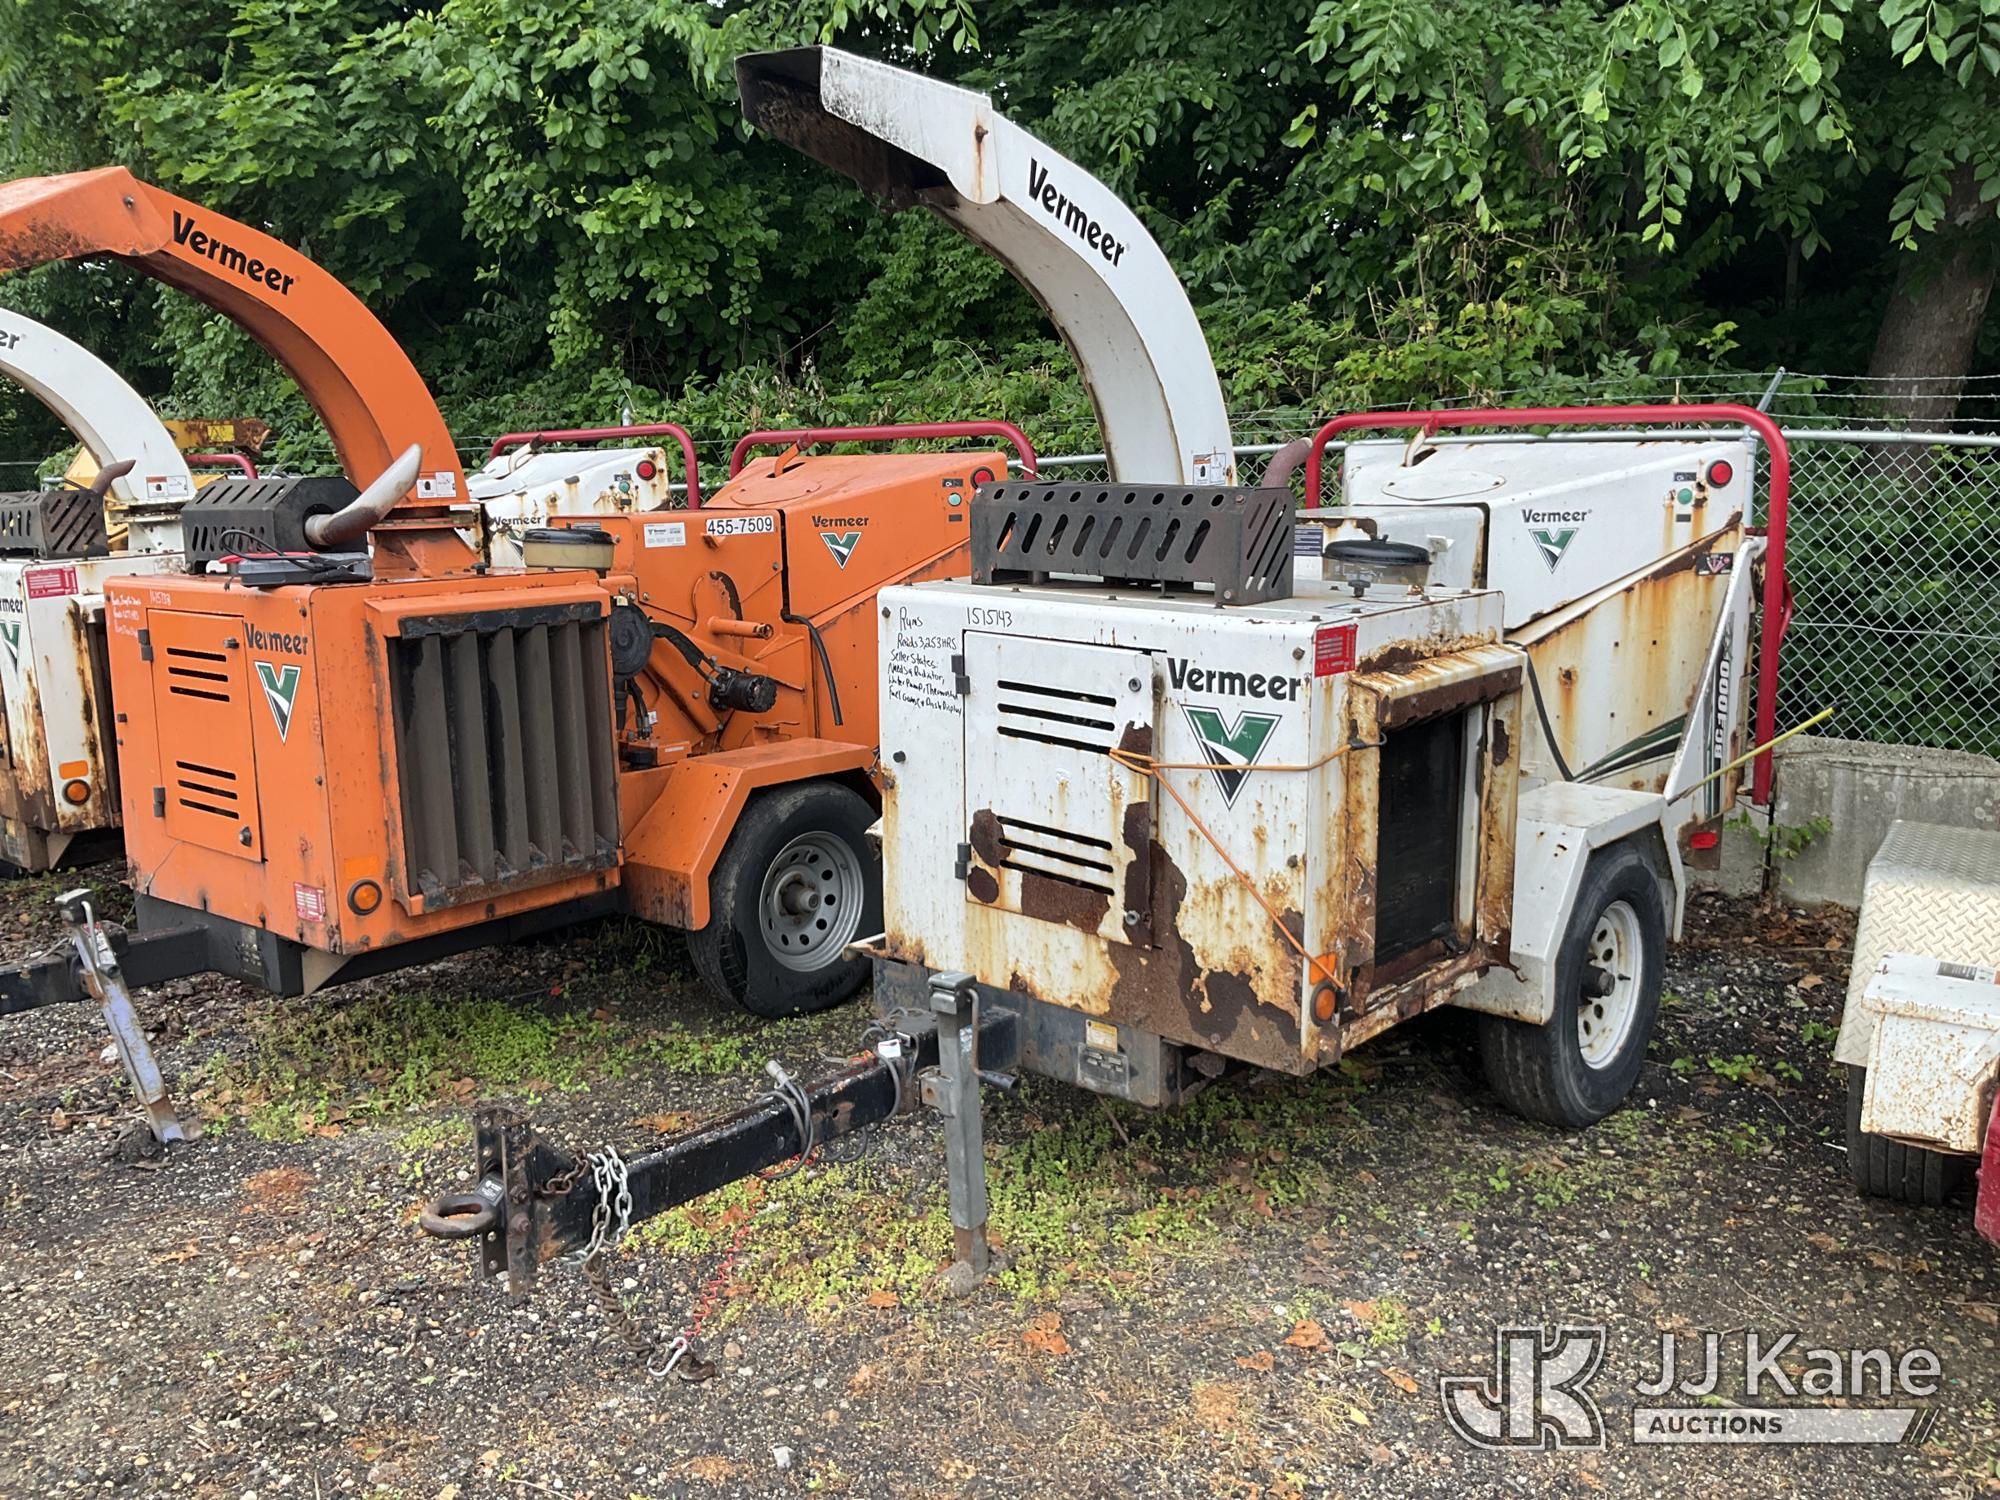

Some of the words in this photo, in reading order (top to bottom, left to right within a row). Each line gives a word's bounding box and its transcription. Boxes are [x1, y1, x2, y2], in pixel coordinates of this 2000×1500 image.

[1029, 157, 1124, 268] Vermeer
[173, 210, 294, 296] Vermeer
[707, 517, 773, 535] 455-7509
[812, 515, 869, 527] Vermeer
[1521, 509, 1588, 523] Vermeer
[899, 606, 923, 631] Runs
[244, 623, 308, 655] Vermeer
[897, 632, 918, 649] Reads
[890, 649, 909, 662] Seller
[1167, 657, 1301, 701] Vermeer
